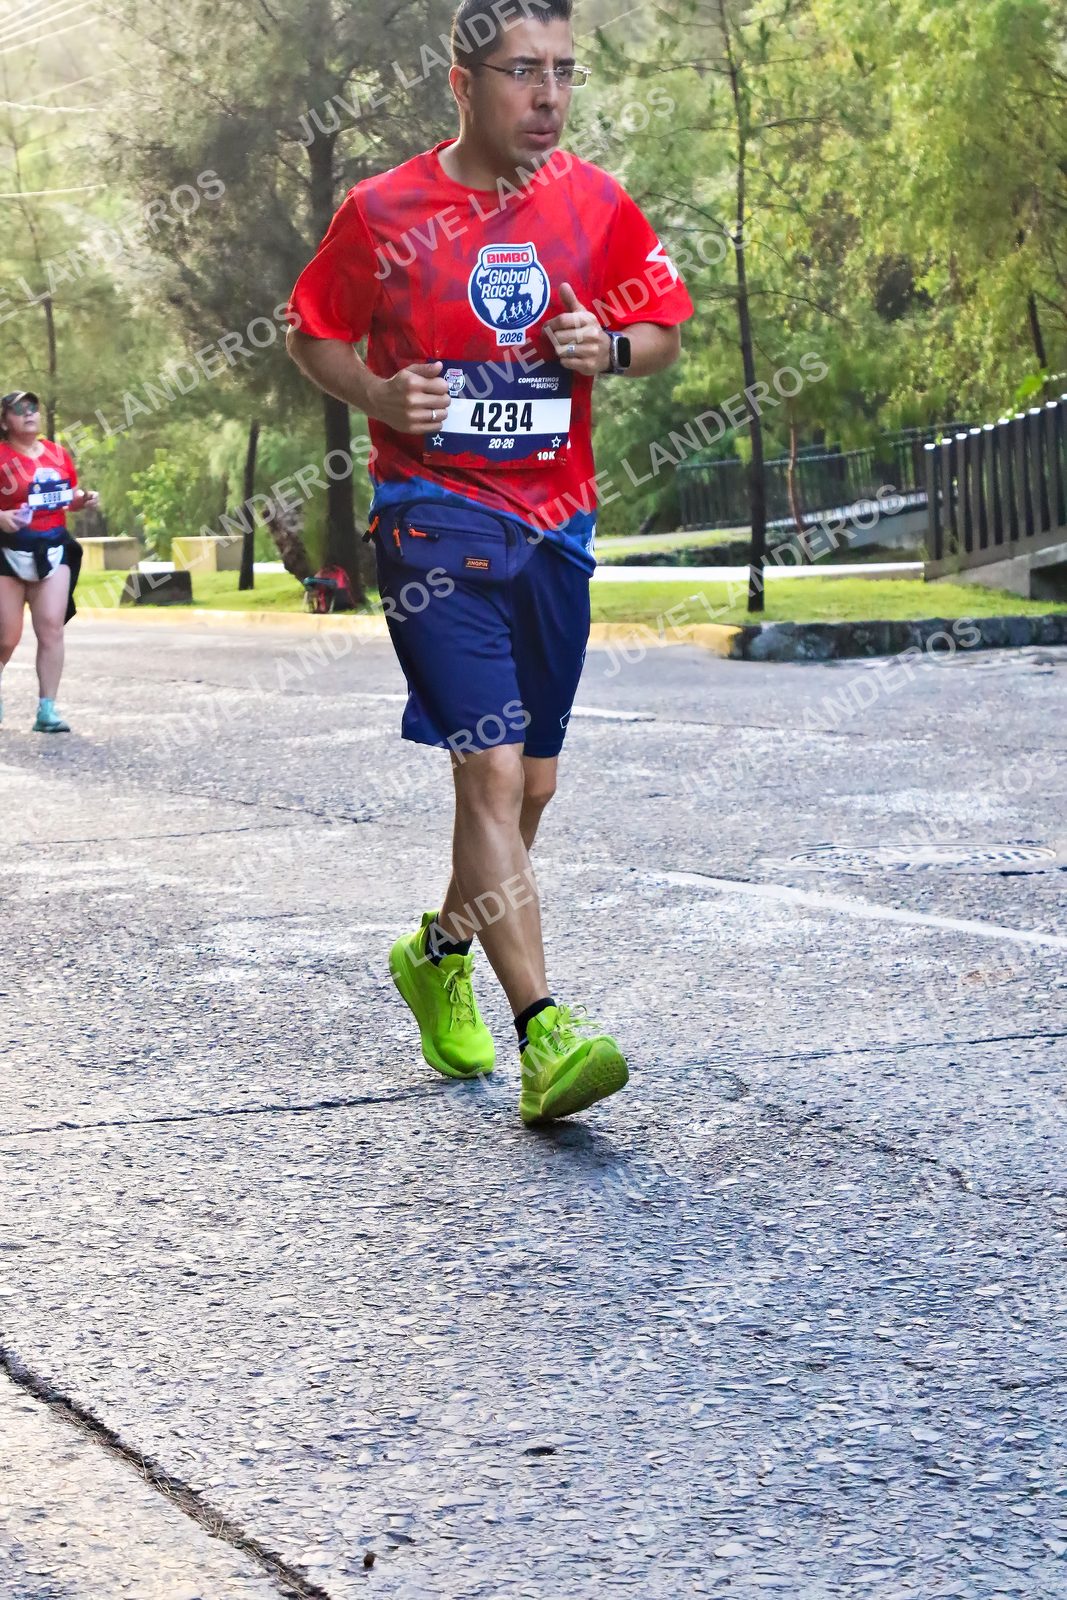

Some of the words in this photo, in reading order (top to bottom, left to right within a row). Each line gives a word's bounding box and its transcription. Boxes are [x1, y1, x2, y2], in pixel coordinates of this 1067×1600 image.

[487, 252, 529, 264] BIMBO
[489, 268, 530, 285] Global
[481, 283, 515, 299] Race
[499, 332, 523, 343] 2026
[470, 402, 533, 433] 4234
[537, 451, 556, 461] 10K
